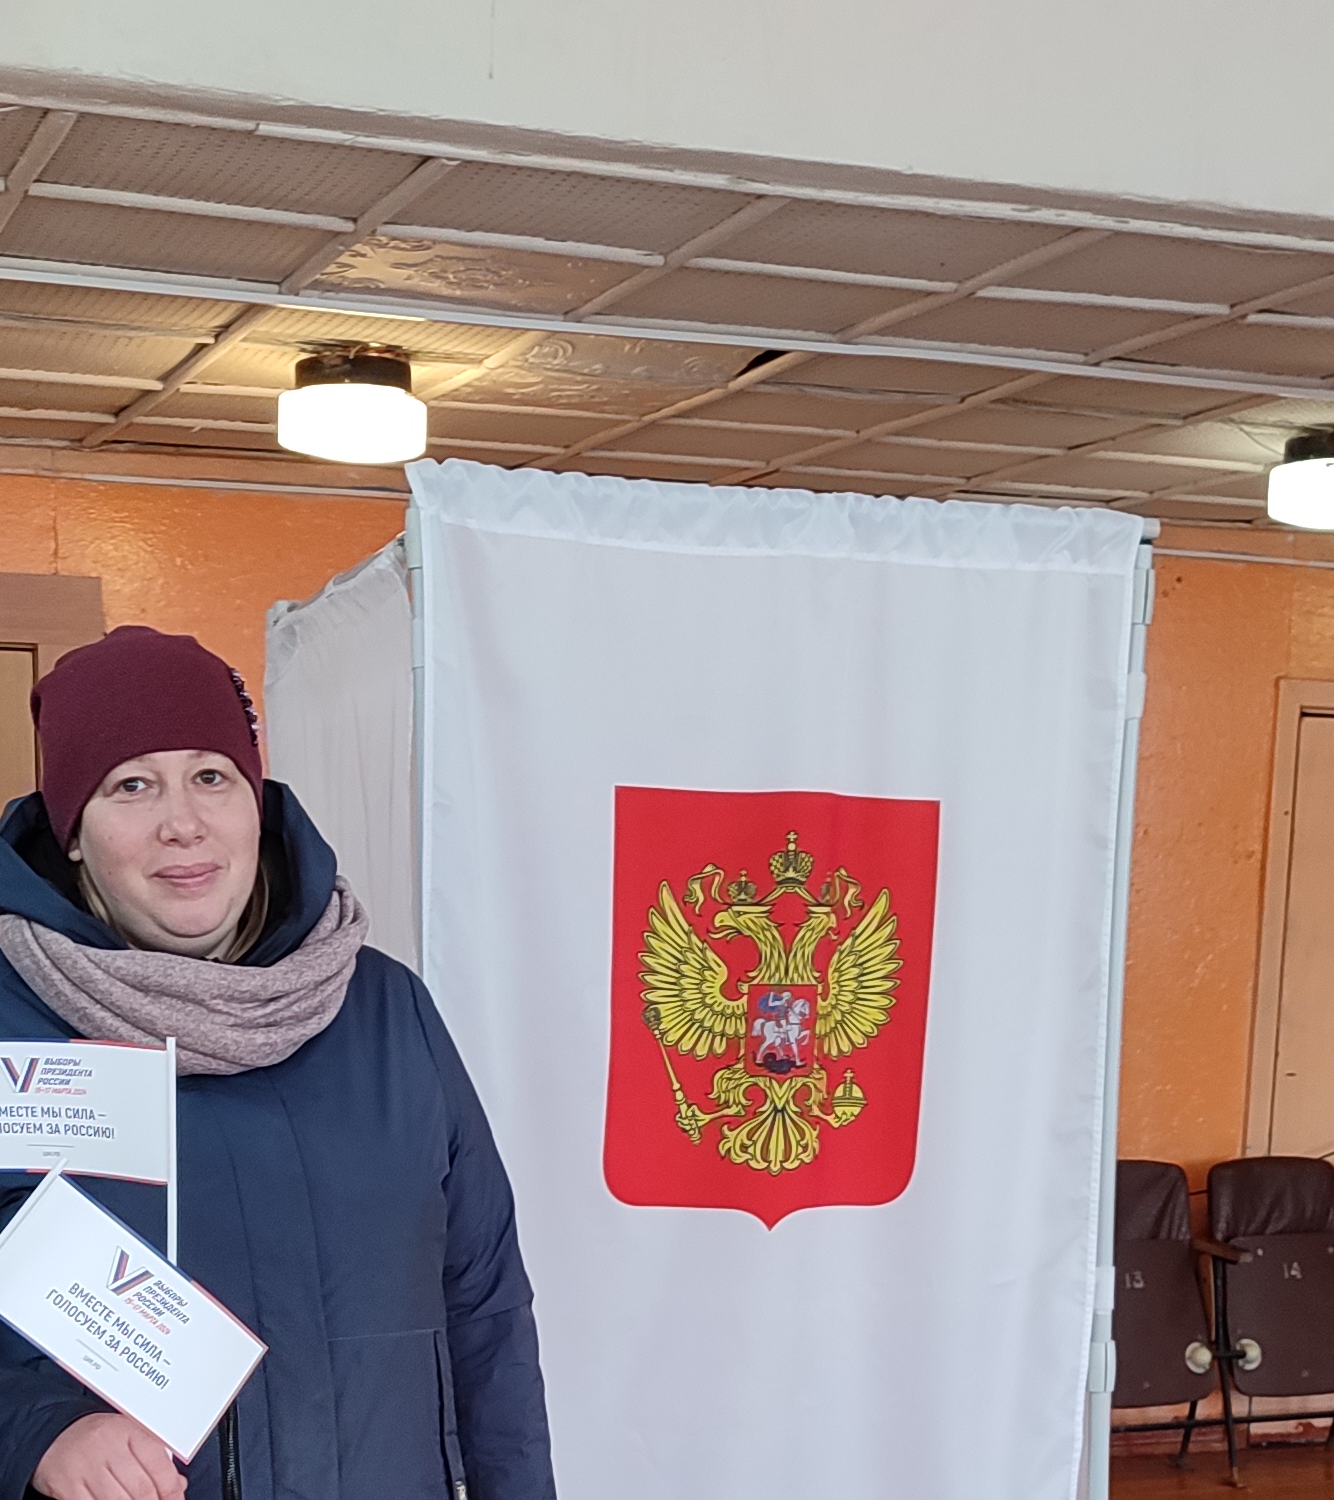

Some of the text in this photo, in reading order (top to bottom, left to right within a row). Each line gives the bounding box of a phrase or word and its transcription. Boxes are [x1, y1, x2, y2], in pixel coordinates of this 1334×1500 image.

[44, 1057, 82, 1066] ВЫБОРЫ
[41, 1068, 92, 1077] ПРЕЗИДЕНТА
[41, 1106, 61, 1118] МЫ
[65, 1107, 96, 1120] СИЛА
[46, 1123, 61, 1135] ЗА
[64, 1124, 115, 1139] РОССИЮ!
[68, 1282, 115, 1323] ВМЕСТЕ
[111, 1316, 136, 1339] МЫ
[133, 1333, 163, 1362] СИЛА
[46, 1289, 169, 1390] ГОЛОСУЕМ ЗА РОССИЮ!
